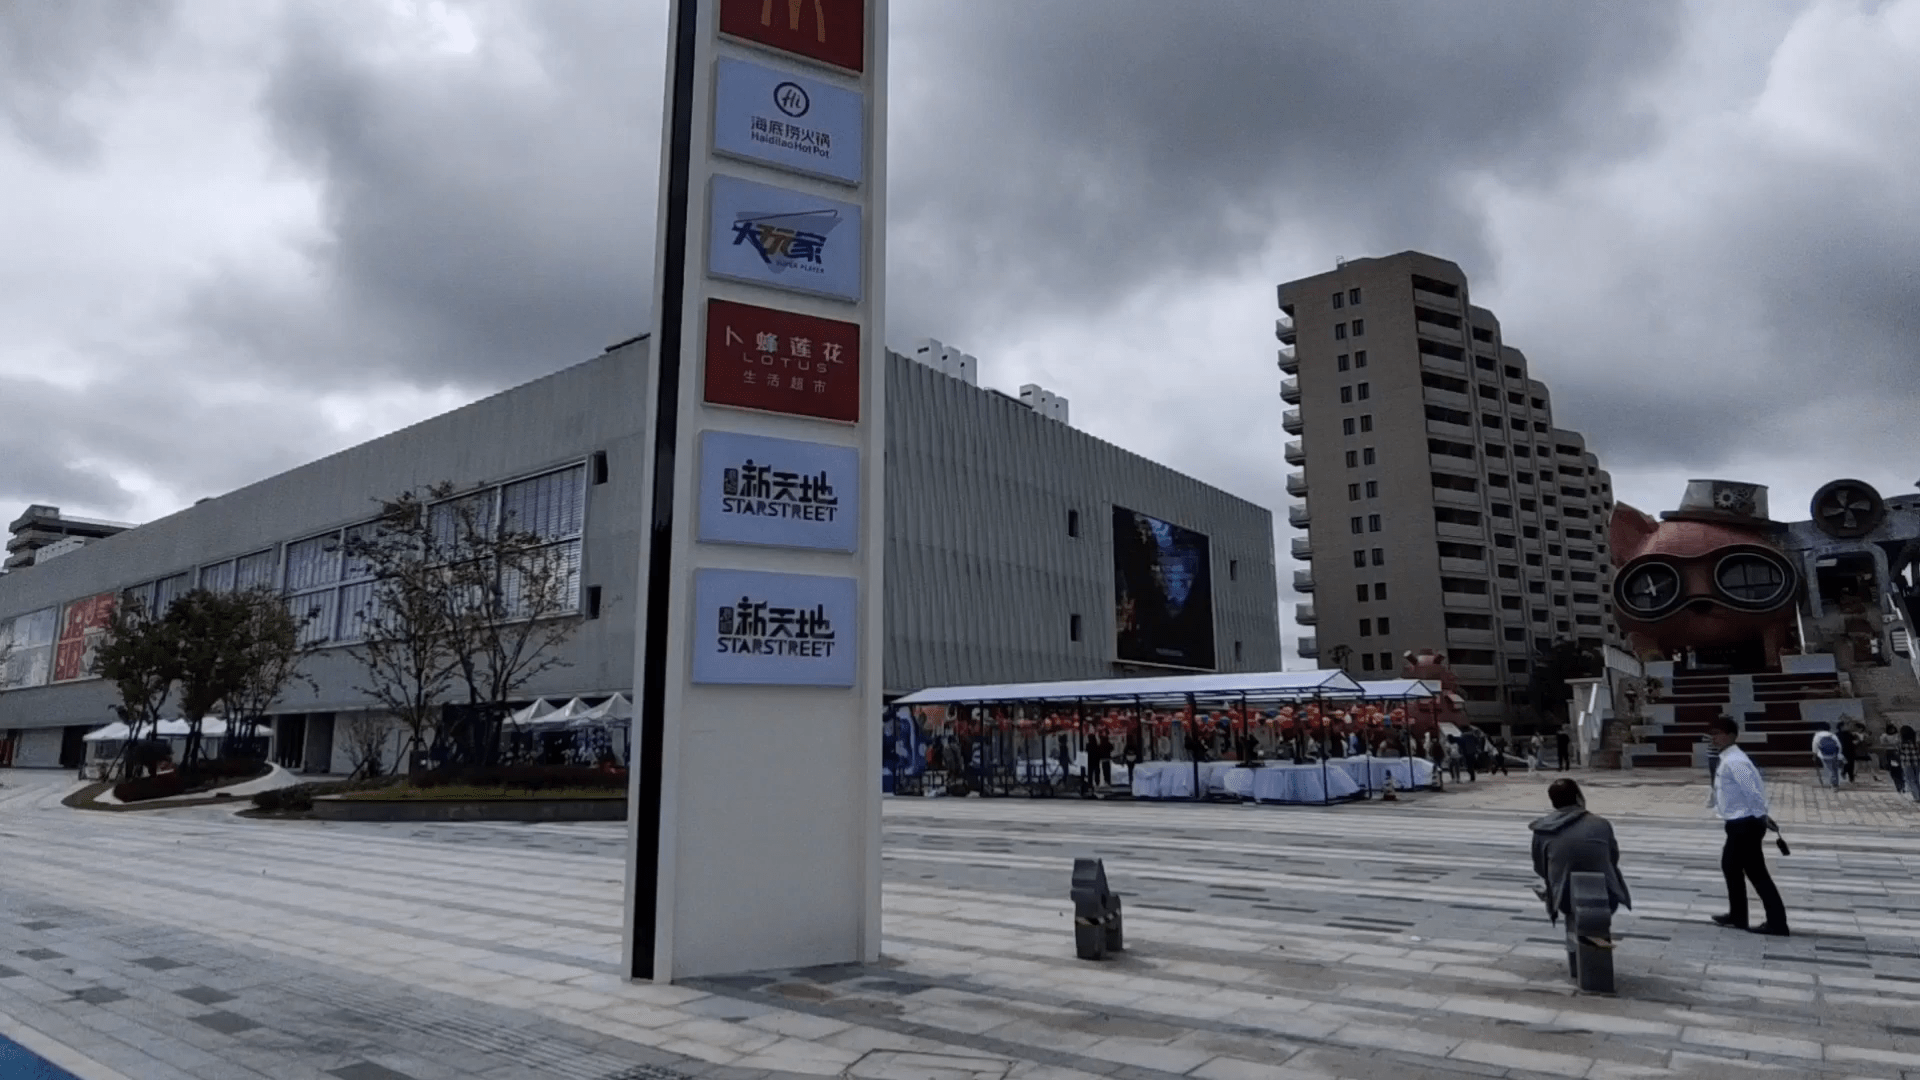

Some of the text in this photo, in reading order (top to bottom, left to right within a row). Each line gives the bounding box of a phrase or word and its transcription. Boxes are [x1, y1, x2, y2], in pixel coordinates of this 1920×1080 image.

[751, 115, 831, 149] 海底捞火锅
[732, 222, 827, 265] 大玩家
[725, 325, 844, 364] 卜蜂莲花
[743, 352, 828, 373] LOTUS
[743, 370, 828, 393] 生活超市
[740, 459, 838, 505] 新天地
[722, 498, 838, 522] STARSTREET
[735, 595, 835, 640] 新天地
[716, 637, 835, 658] STARSTREET
